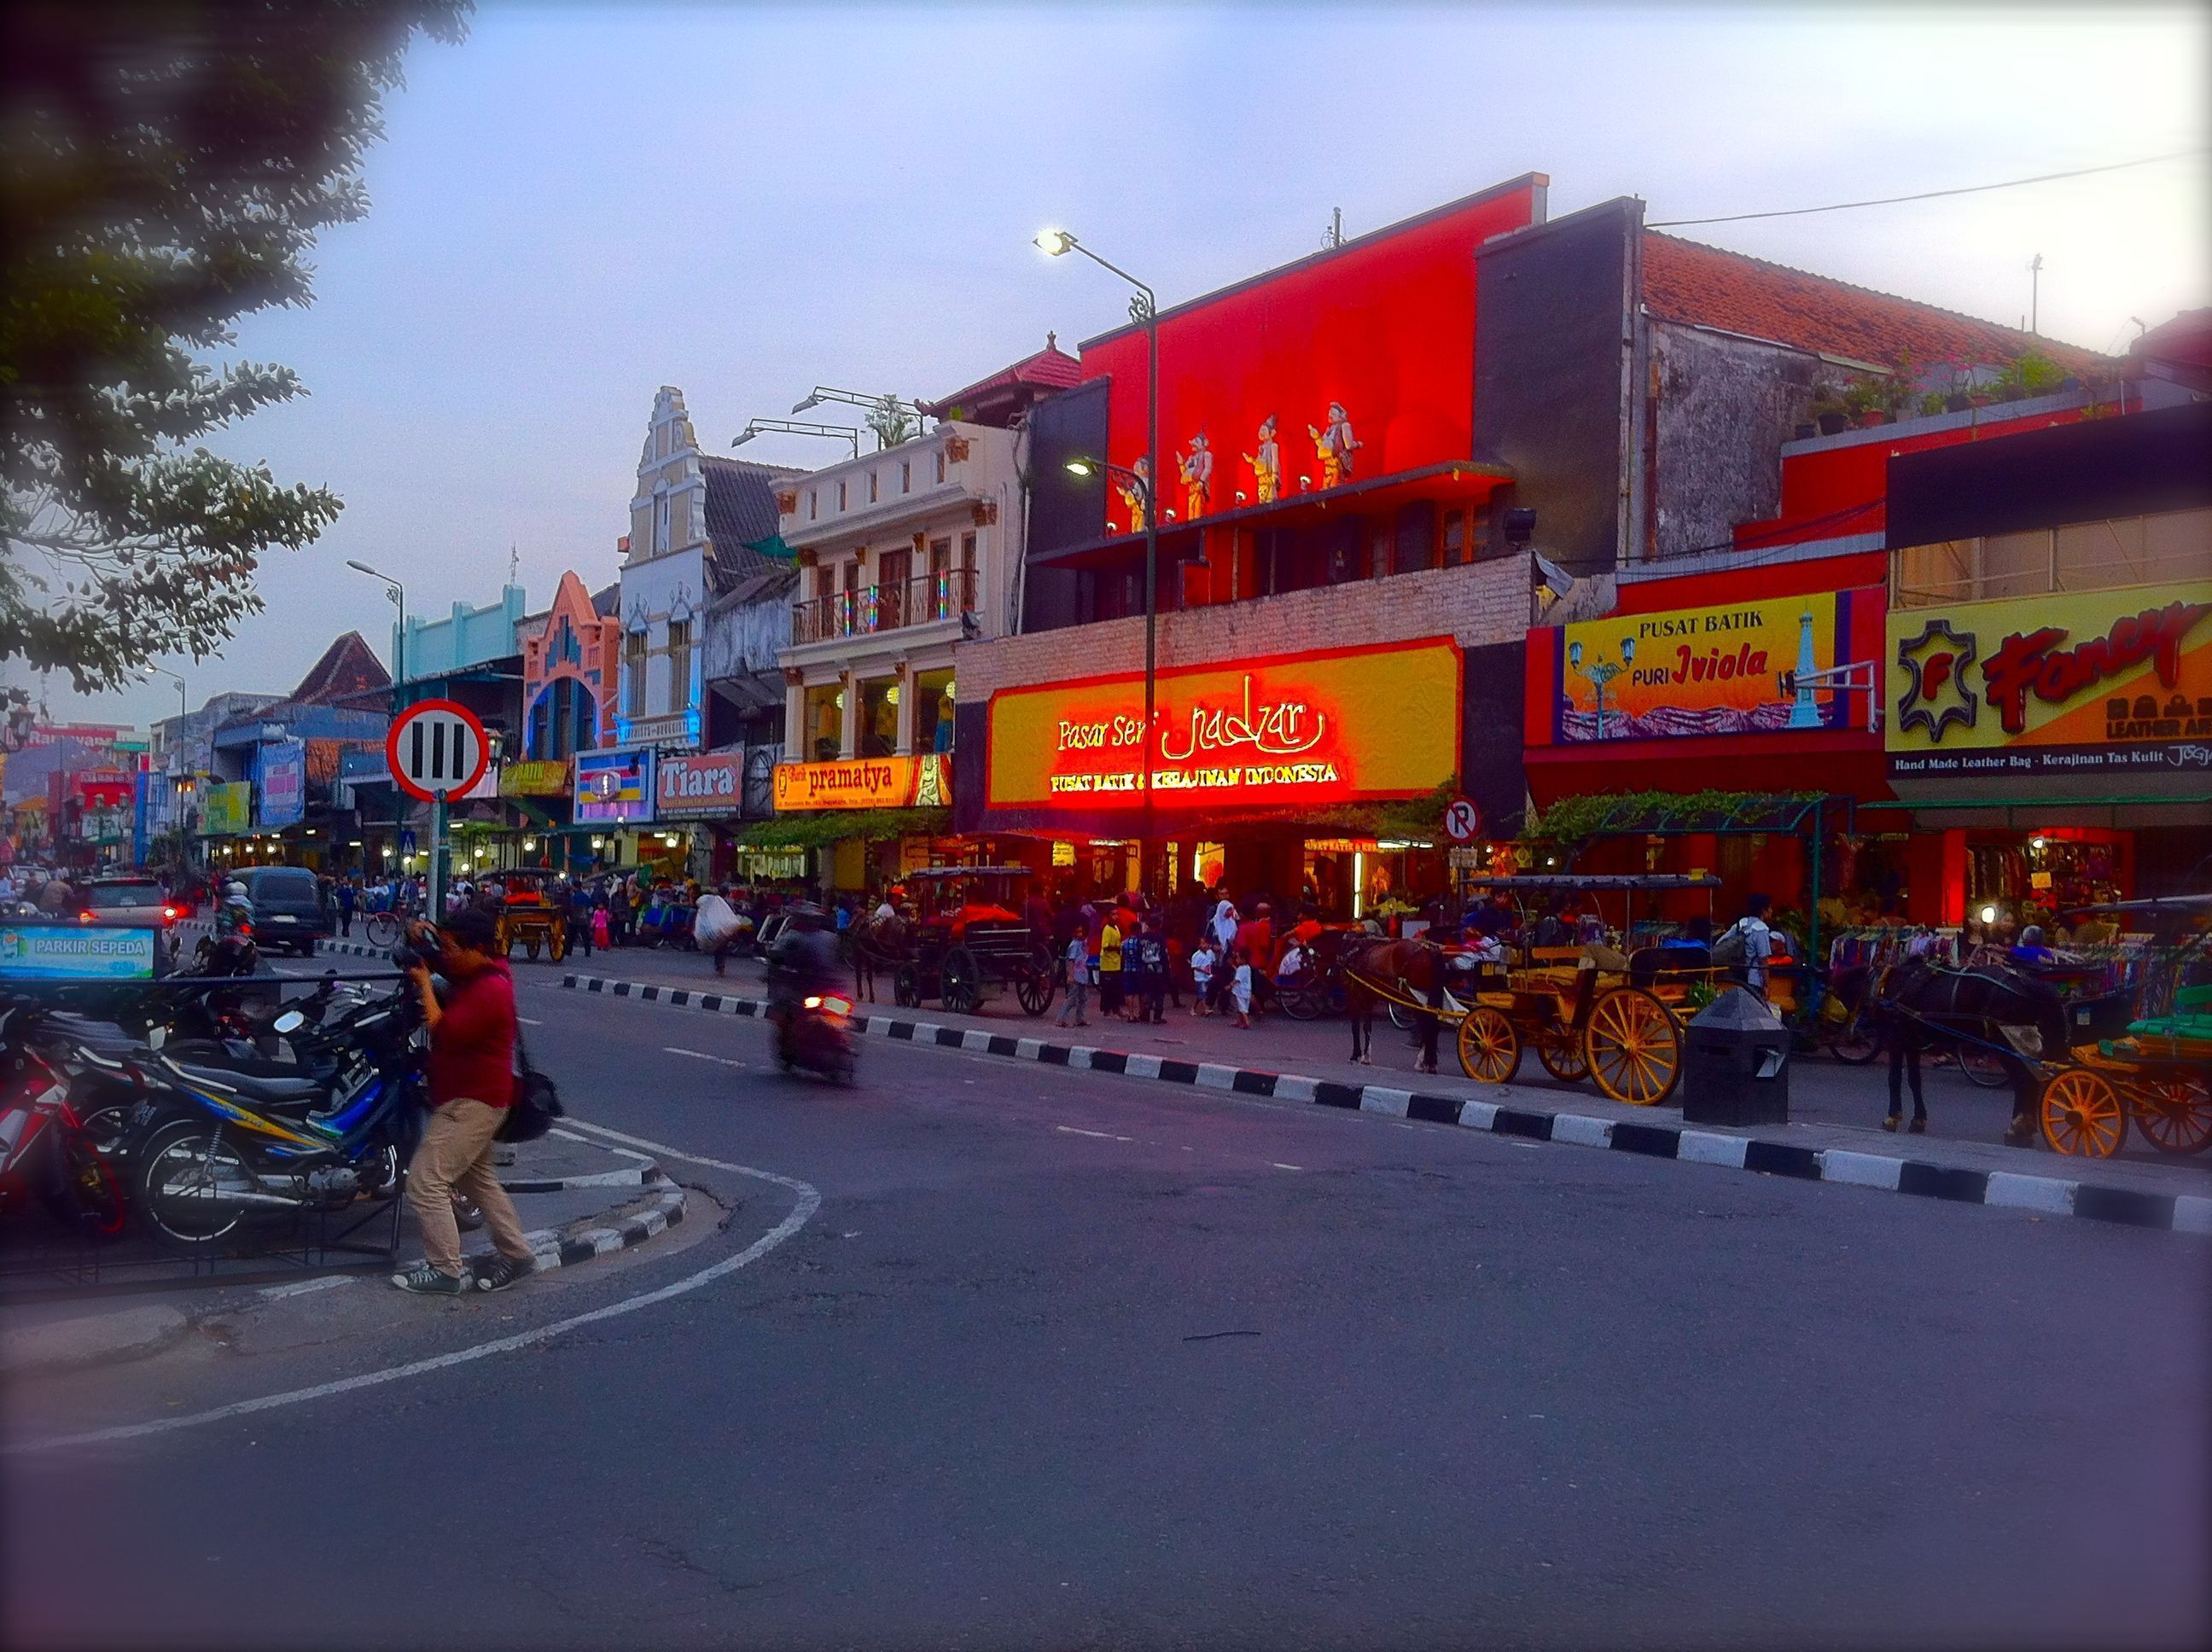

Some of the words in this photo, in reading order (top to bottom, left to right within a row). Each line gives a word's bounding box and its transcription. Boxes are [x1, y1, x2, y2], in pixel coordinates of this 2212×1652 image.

[1640, 617, 1699, 638] PUSAT
[1705, 610, 1763, 632] BATIK
[1633, 667, 1669, 687] PURI
[1922, 652, 1954, 701] F
[1057, 720, 1109, 751] Pasar
[1895, 759, 1925, 770] Hand
[1929, 759, 1959, 769] Made
[1963, 756, 2005, 767] Leather
[2009, 755, 2031, 768] Bag
[2042, 753, 2104, 766] Kerajinan
[2106, 752, 2128, 763] Tas
[661, 762, 734, 797] Tiara
[809, 760, 893, 798] pramatya
[1051, 773, 1092, 792] PUSAT
[1093, 771, 1135, 792] BATIK
[1151, 767, 1242, 790] KERAJINAN
[1245, 764, 1338, 786] INDONESIA
[1454, 805, 1470, 834] P
[36, 939, 88, 955] PARKIR
[90, 939, 145, 956] SEPEDA
